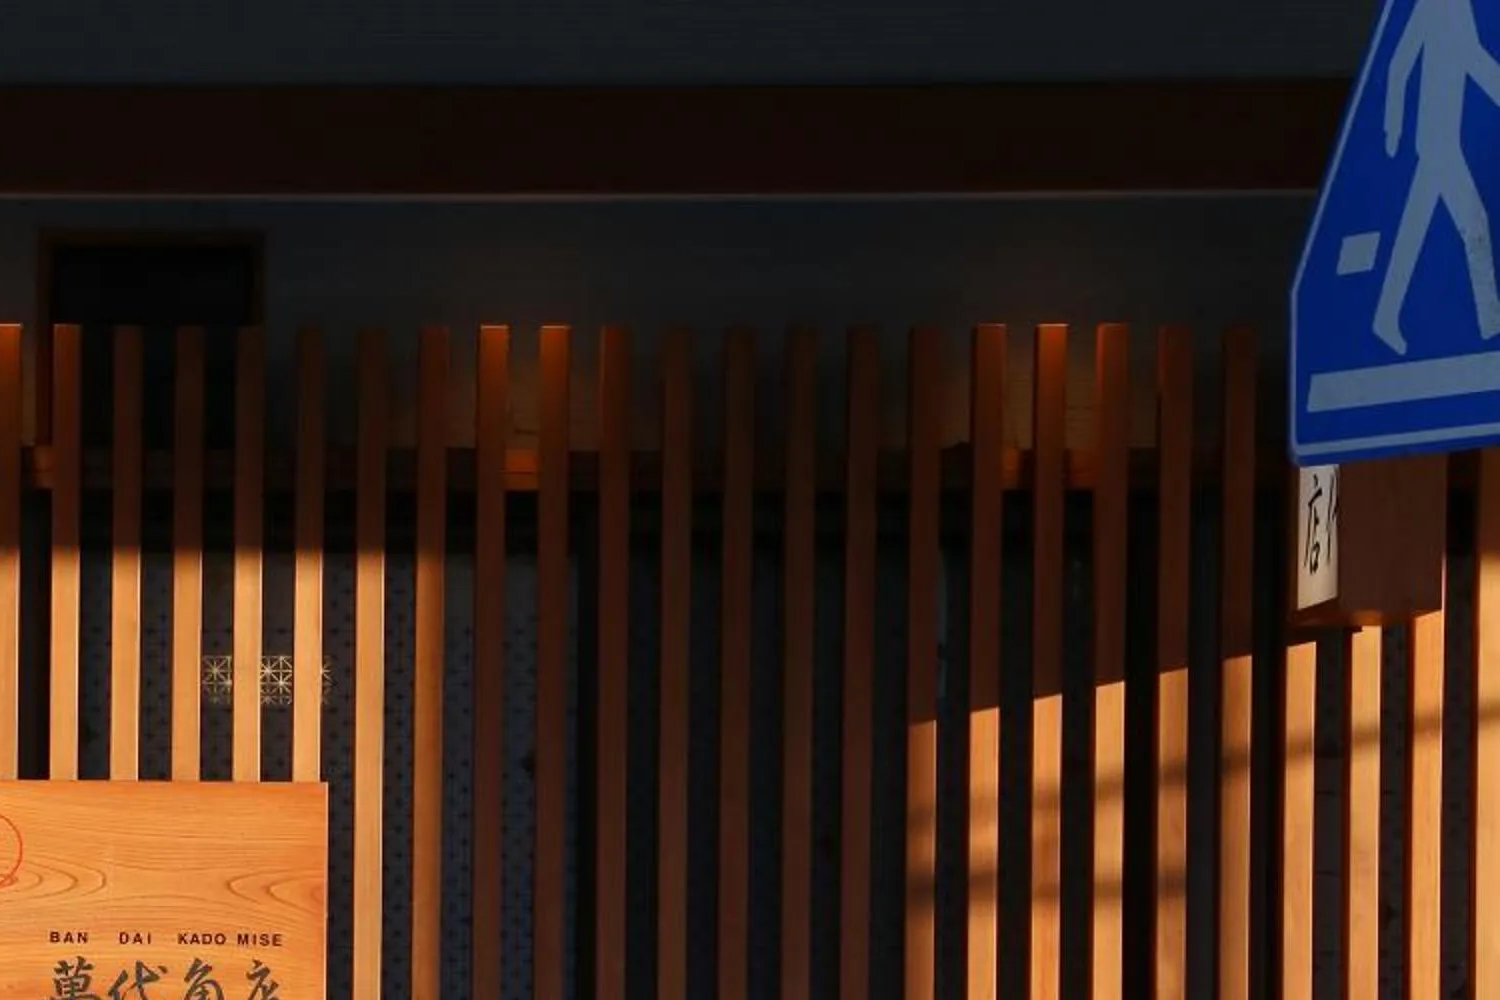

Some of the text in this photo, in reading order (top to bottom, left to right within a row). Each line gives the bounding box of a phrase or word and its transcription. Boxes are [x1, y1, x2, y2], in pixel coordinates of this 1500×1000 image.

[49, 930, 284, 948] BAN DAI KADO MISE
